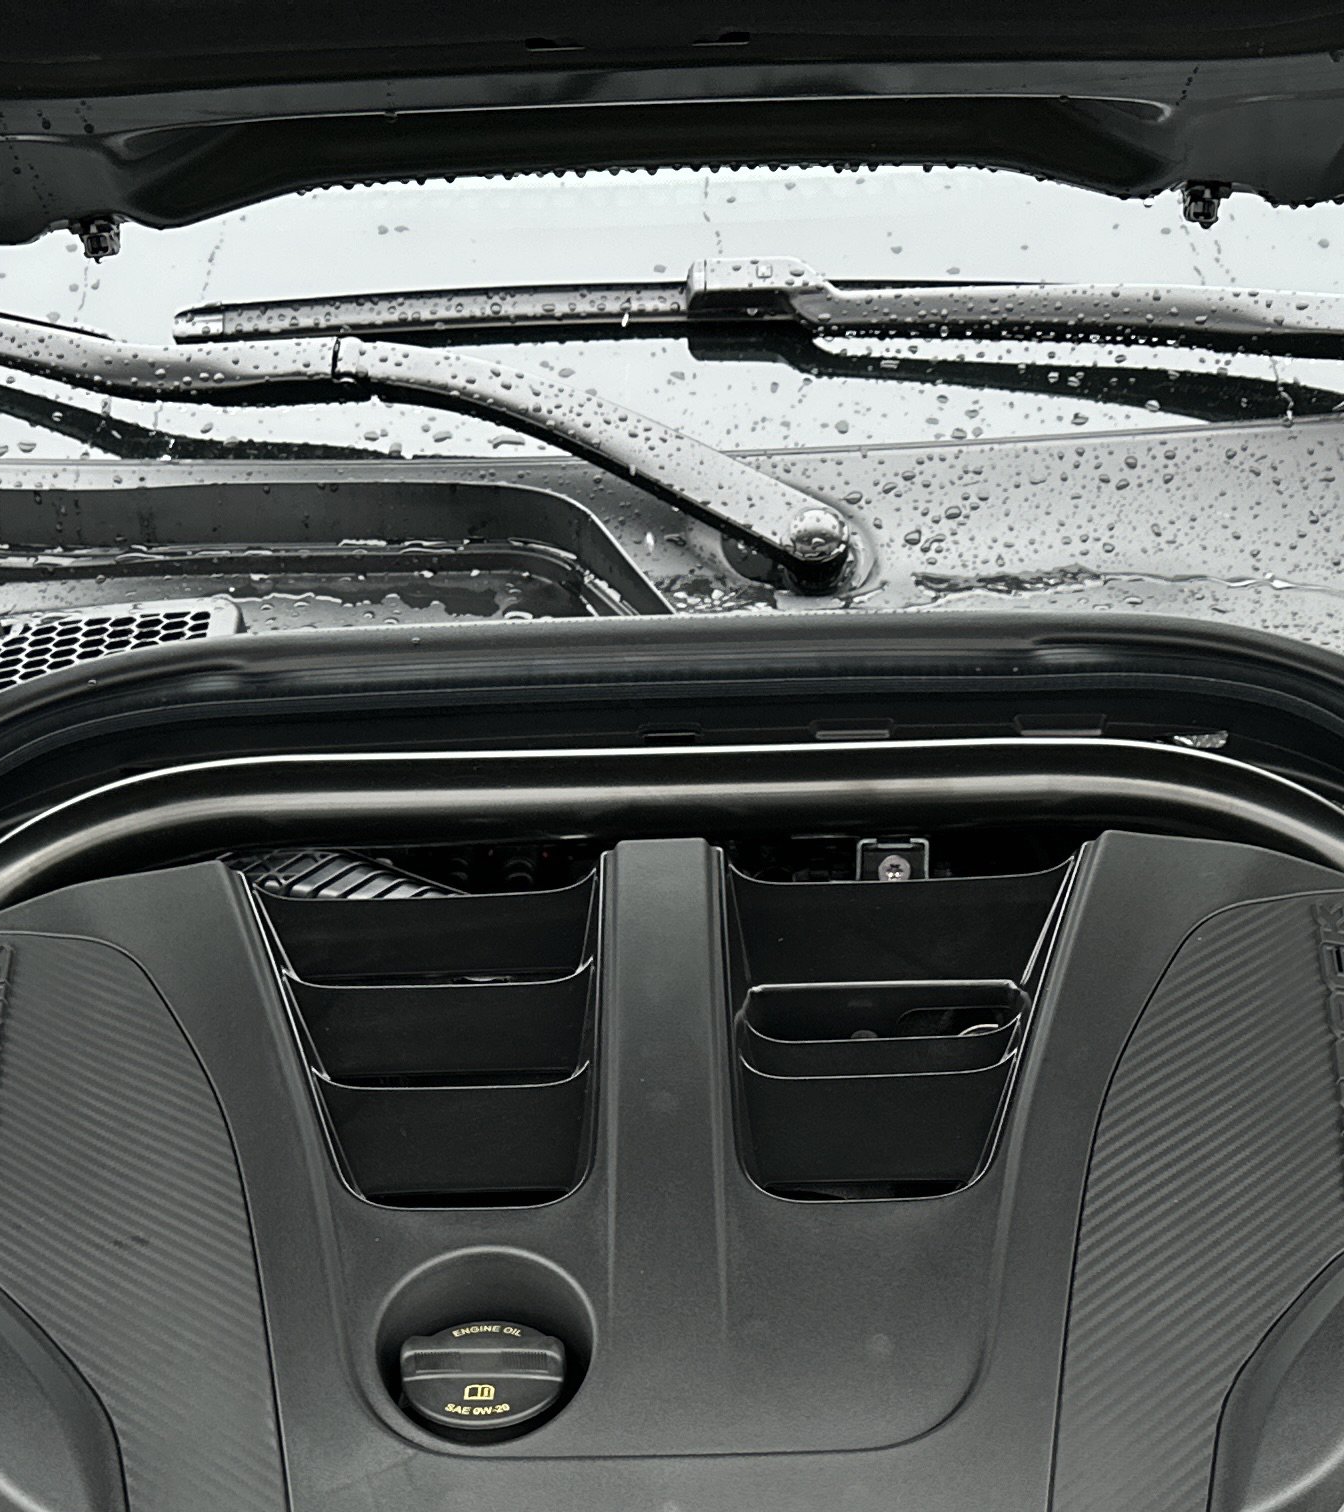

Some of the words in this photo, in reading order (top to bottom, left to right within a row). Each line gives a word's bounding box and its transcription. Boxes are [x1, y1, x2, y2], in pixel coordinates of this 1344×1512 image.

[451, 1325, 500, 1339] ENGINE
[503, 1326, 522, 1337] OIL
[444, 1402, 471, 1416] SAE
[472, 1403, 511, 1416] 0W-20
